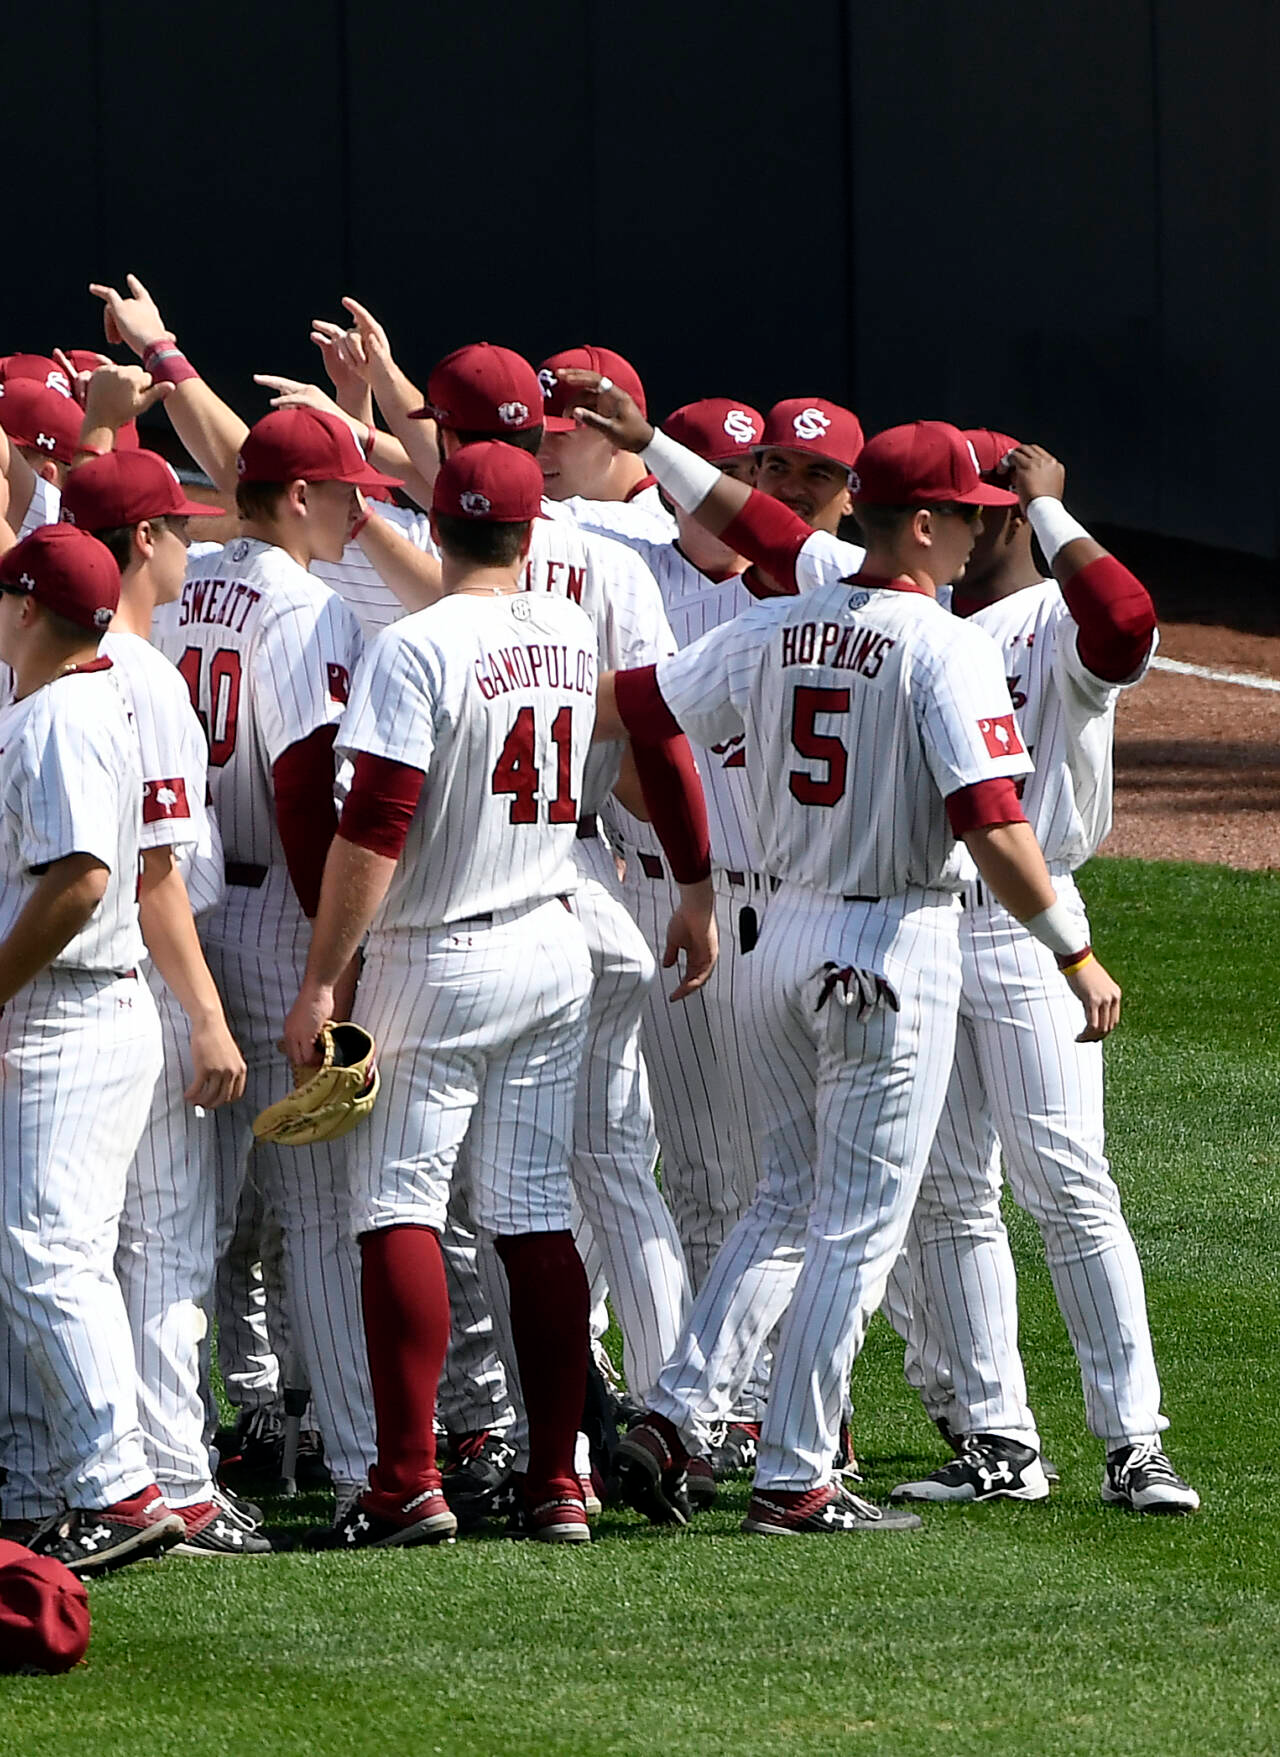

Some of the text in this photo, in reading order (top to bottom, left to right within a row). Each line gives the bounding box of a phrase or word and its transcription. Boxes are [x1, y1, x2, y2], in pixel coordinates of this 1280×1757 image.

[179, 577, 261, 633] SWEATT
[474, 645, 594, 700] GANOPULOS
[782, 622, 895, 679] HOPKINS
[492, 705, 577, 825] 41
[788, 685, 851, 808] 5
